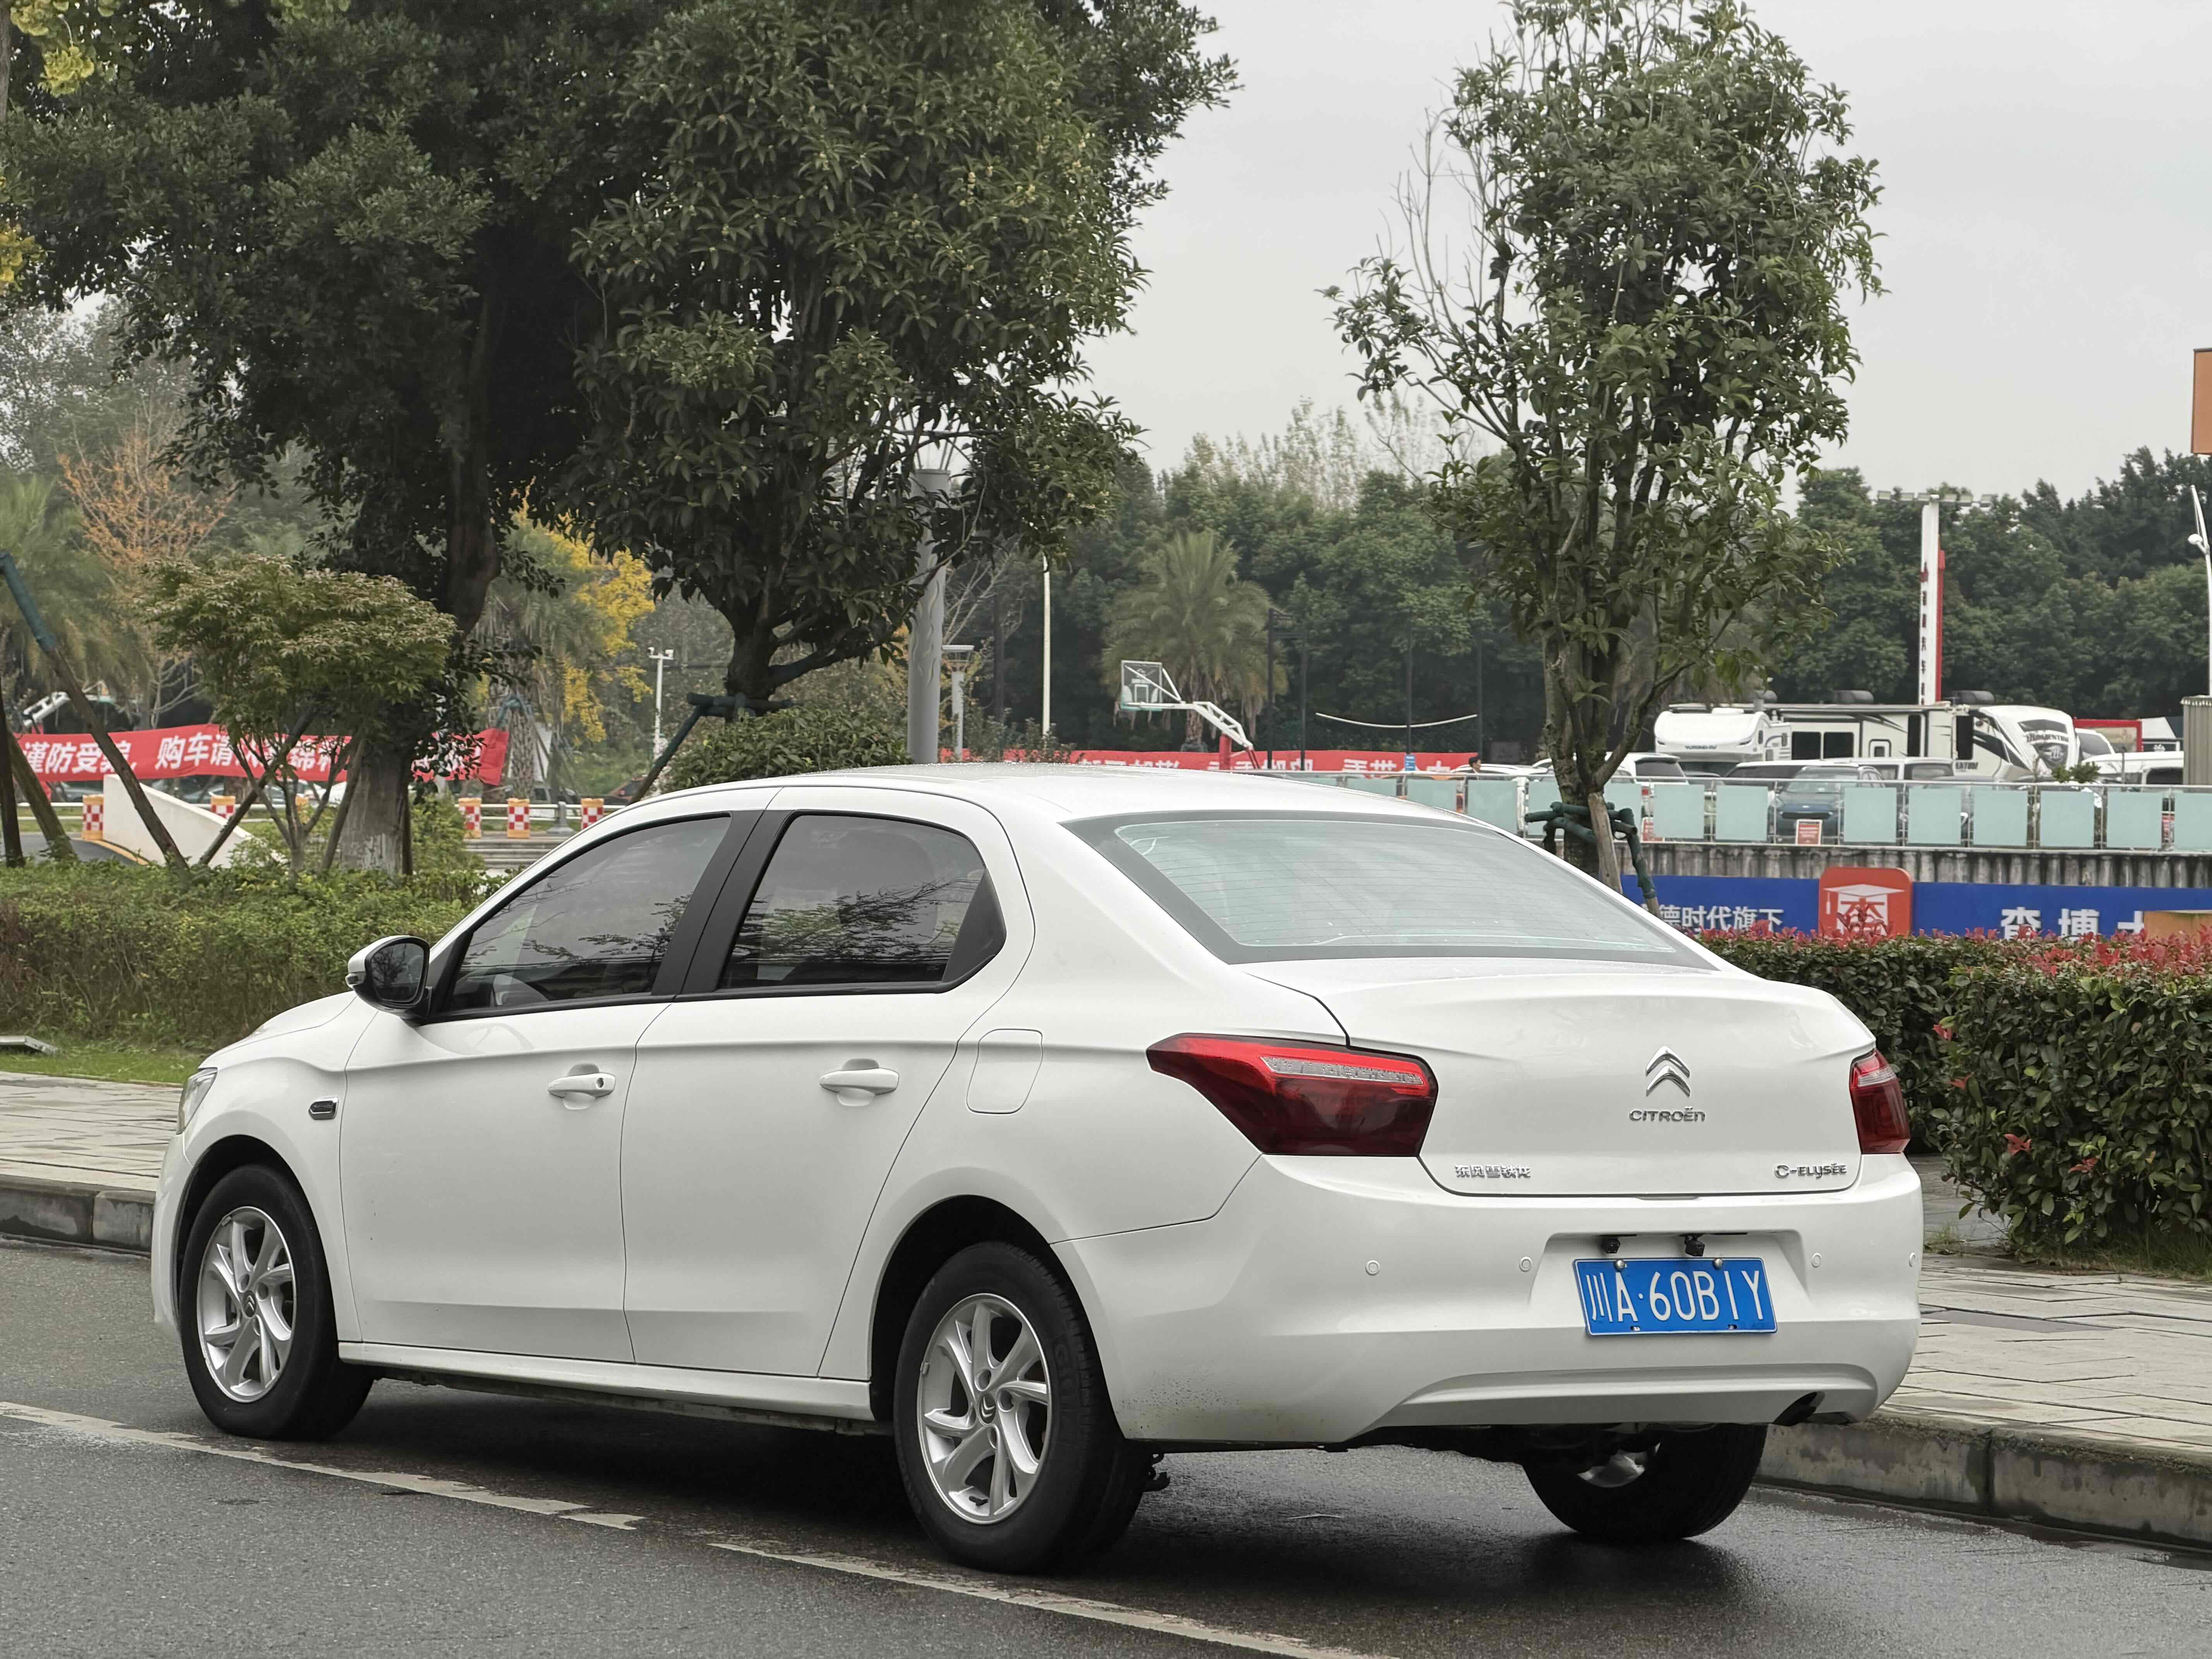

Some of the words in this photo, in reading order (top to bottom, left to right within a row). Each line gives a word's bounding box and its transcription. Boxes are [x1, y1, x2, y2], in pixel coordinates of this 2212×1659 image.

[1640, 904, 1784, 932] 德时代旗下
[1455, 1165, 1531, 1178] 东风雪铁龙
